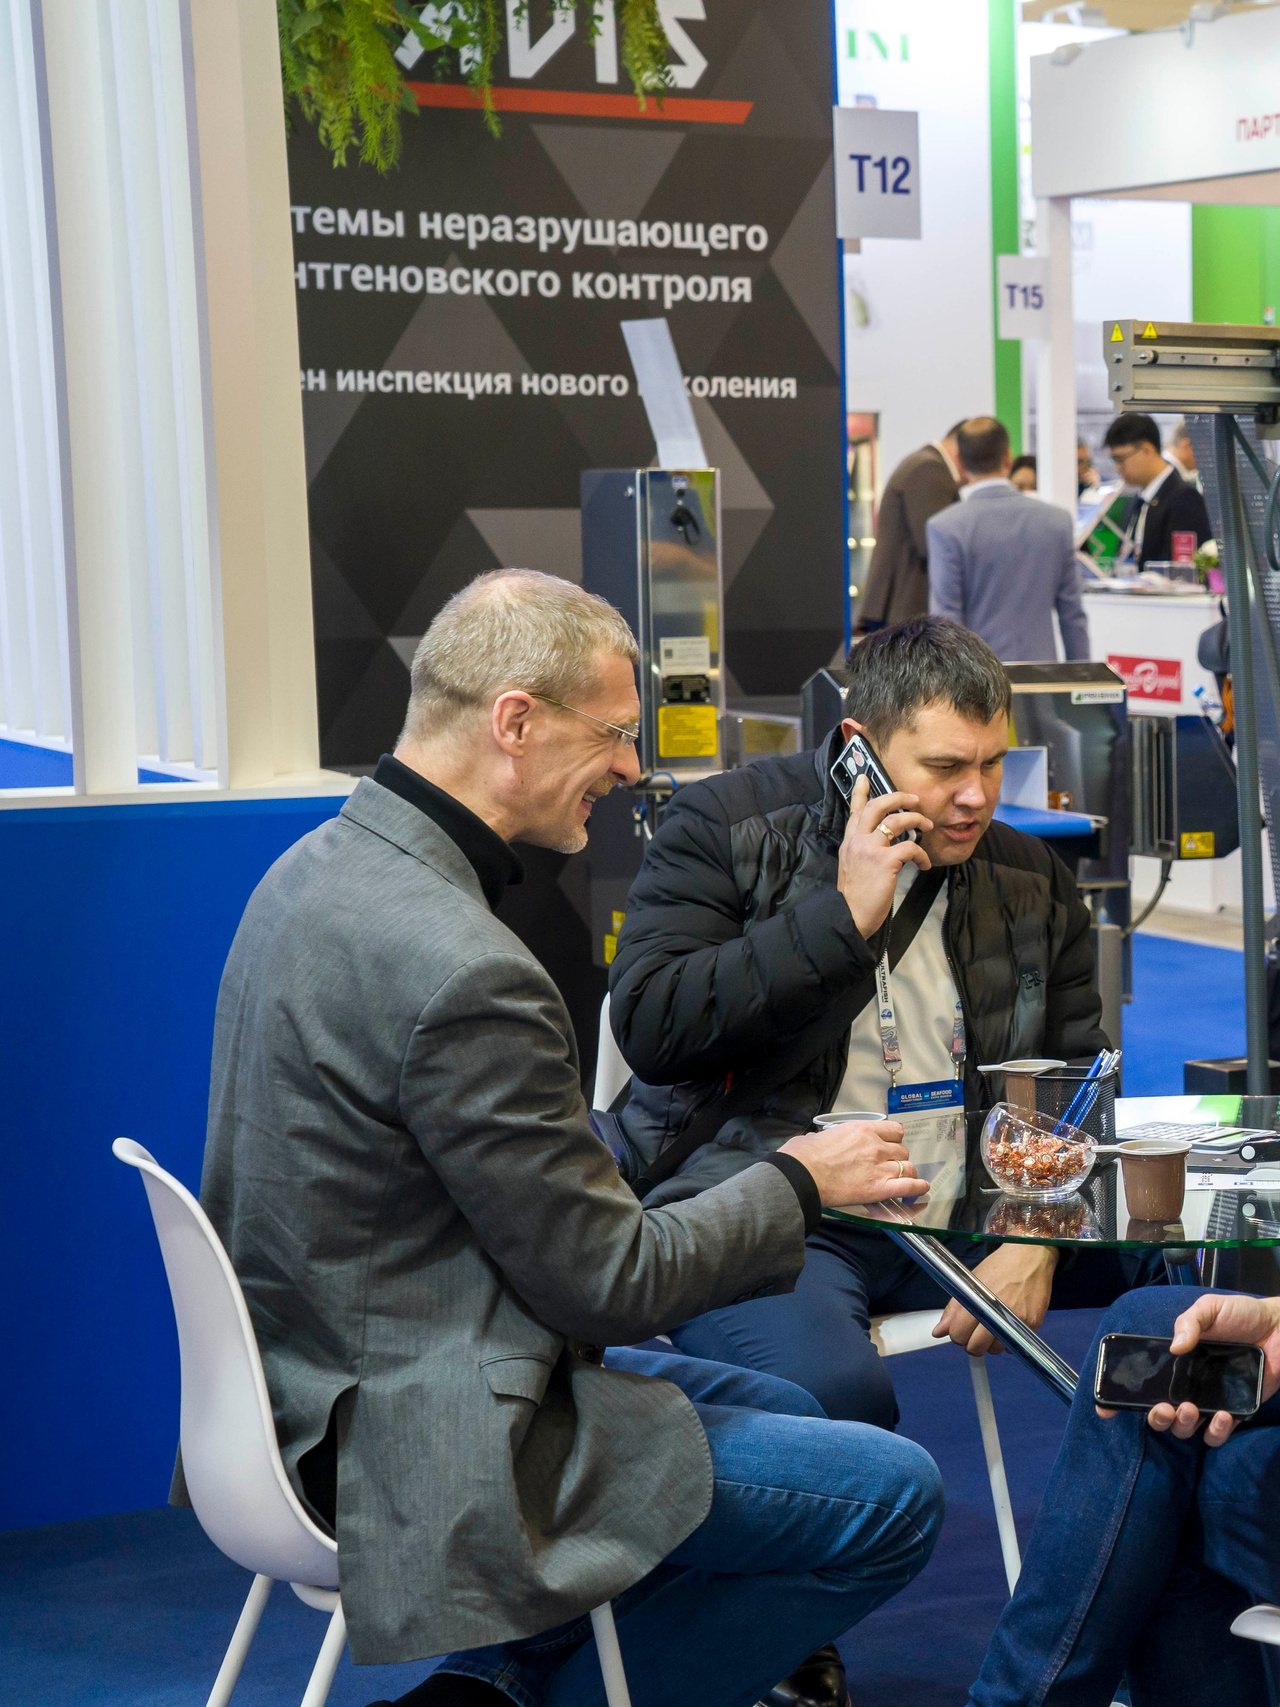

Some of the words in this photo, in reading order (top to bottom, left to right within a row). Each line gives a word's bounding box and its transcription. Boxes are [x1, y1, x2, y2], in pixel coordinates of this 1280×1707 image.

[849, 154, 911, 195] T12
[419, 211, 769, 258] неразрушающего
[572, 271, 752, 310] контроля
[1005, 283, 1044, 310] T15
[336, 369, 512, 400] инспекция
[521, 373, 630, 396] нового
